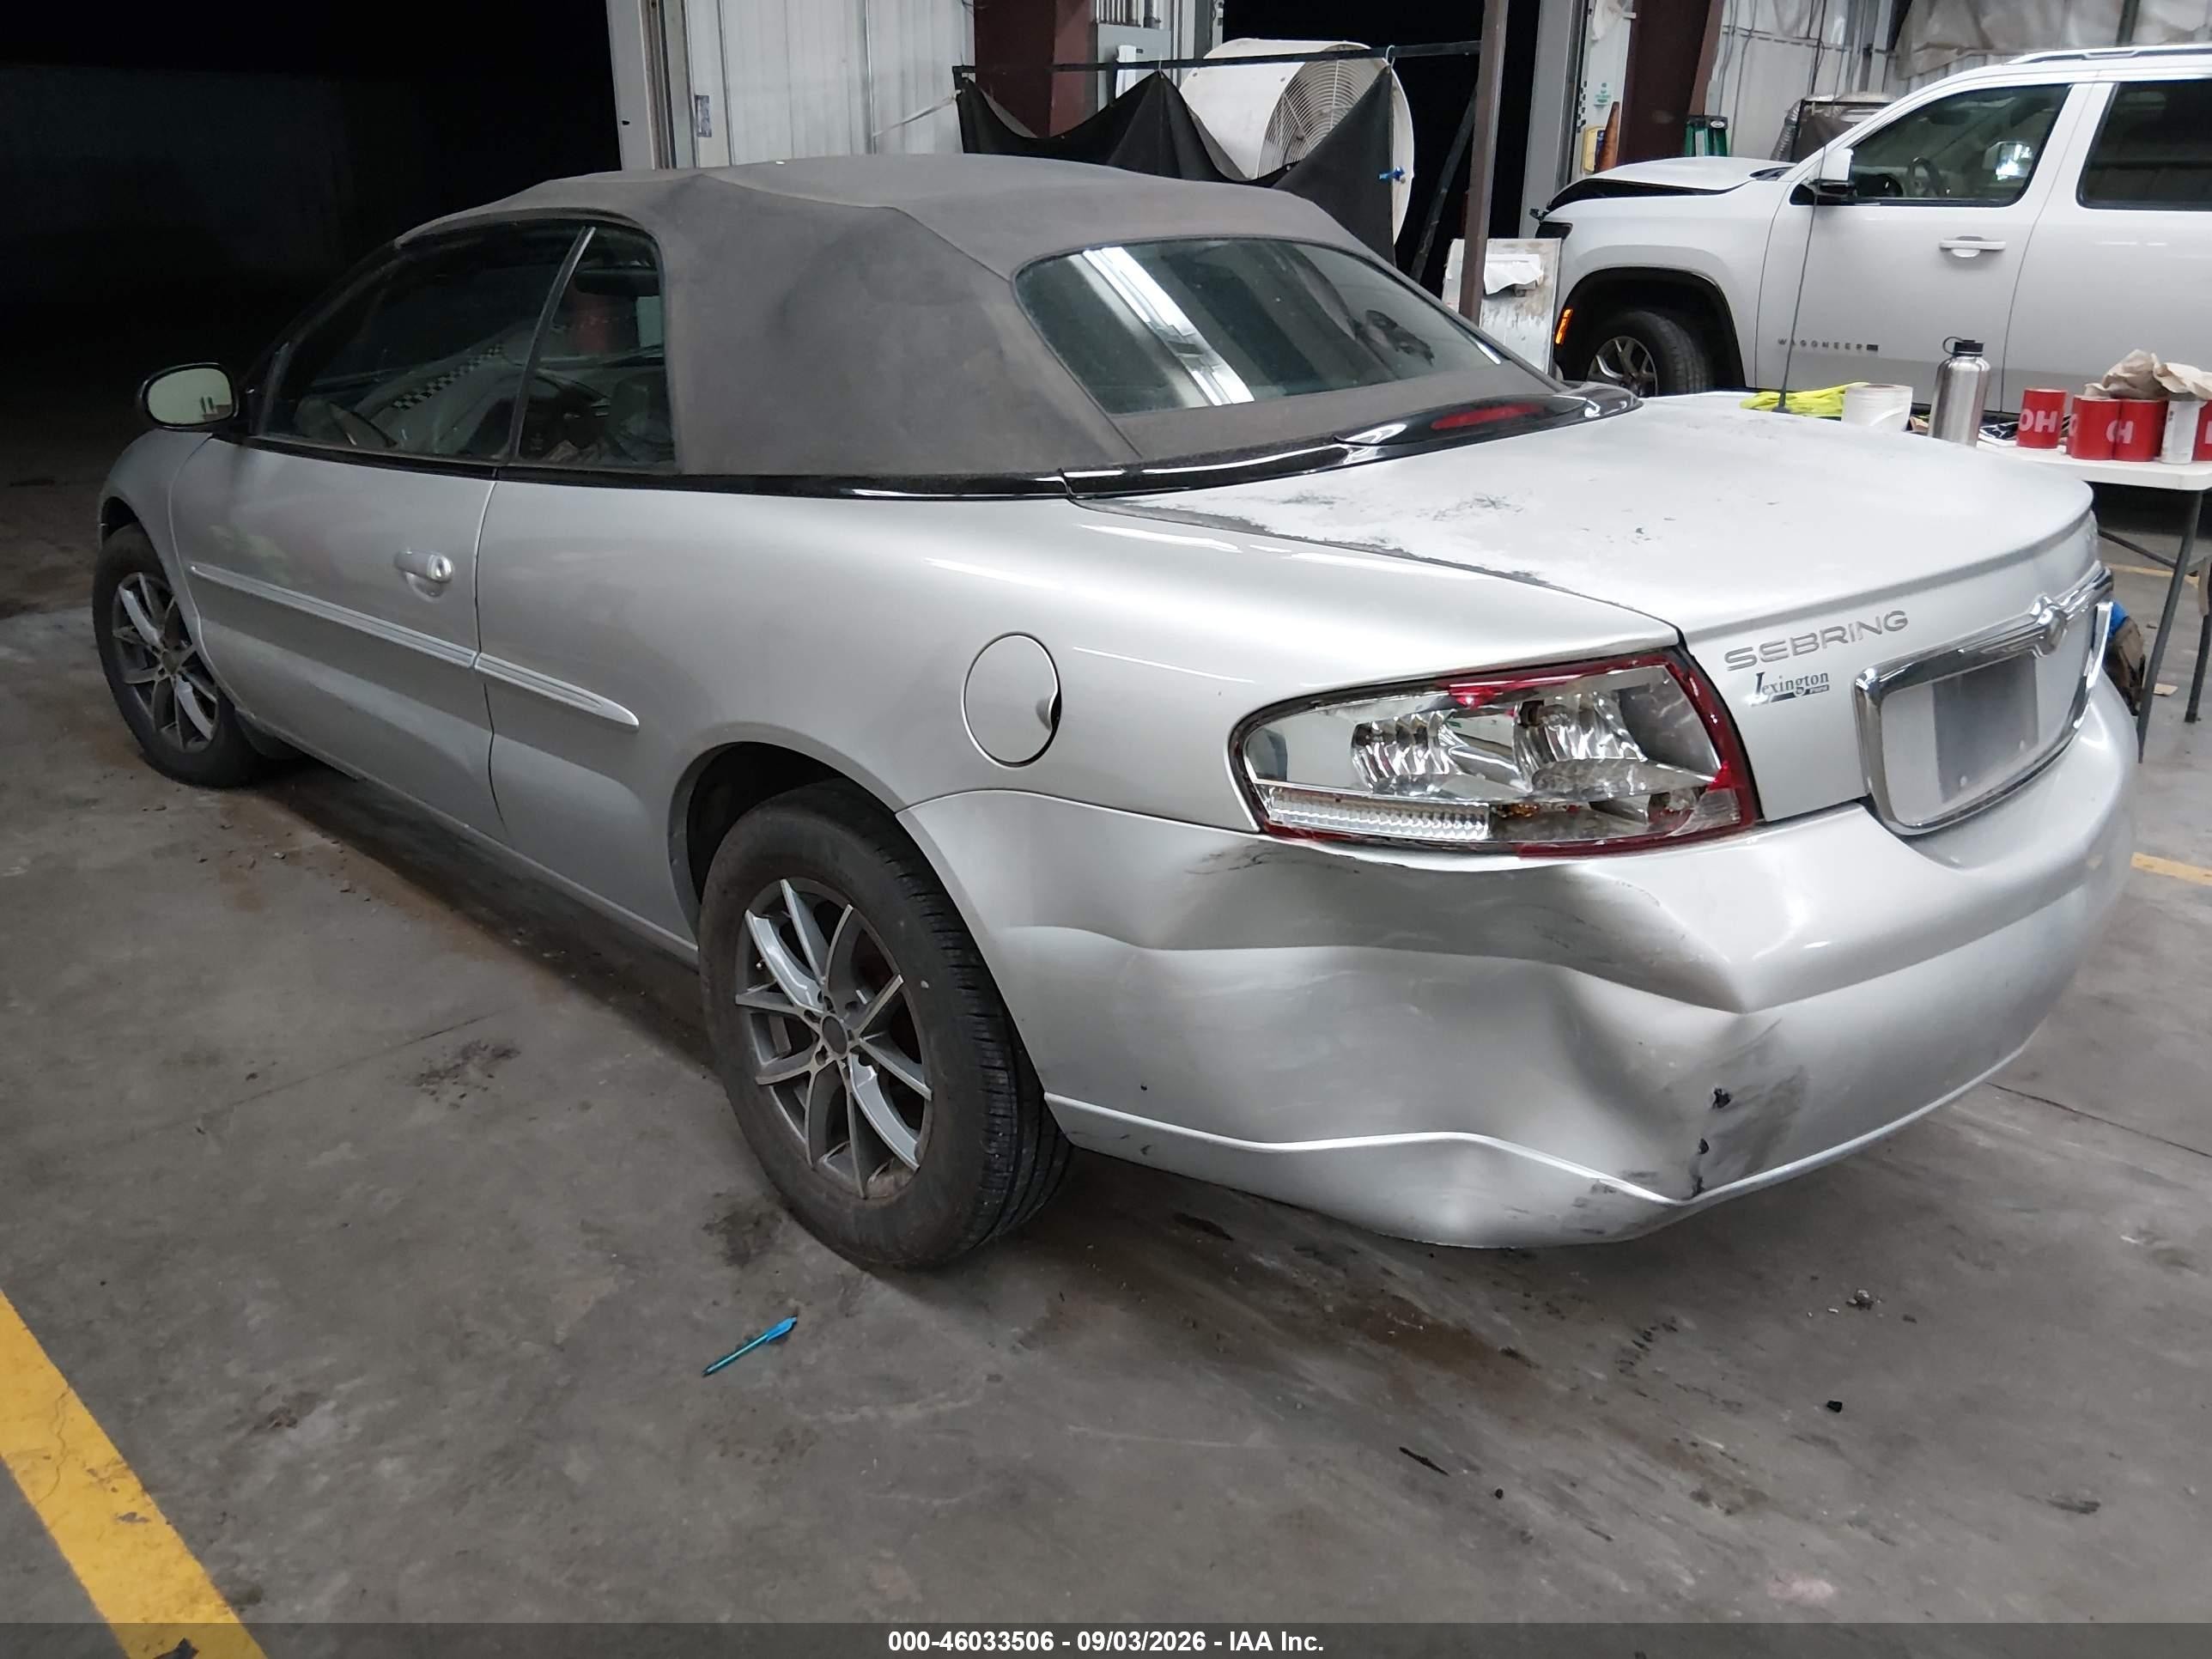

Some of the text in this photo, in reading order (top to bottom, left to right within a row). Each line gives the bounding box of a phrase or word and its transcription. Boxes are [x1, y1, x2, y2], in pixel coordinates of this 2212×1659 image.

[2019, 408, 2058, 433] OH
[1723, 610, 1909, 672] SEBRING
[1749, 671, 1829, 706] Lexington
